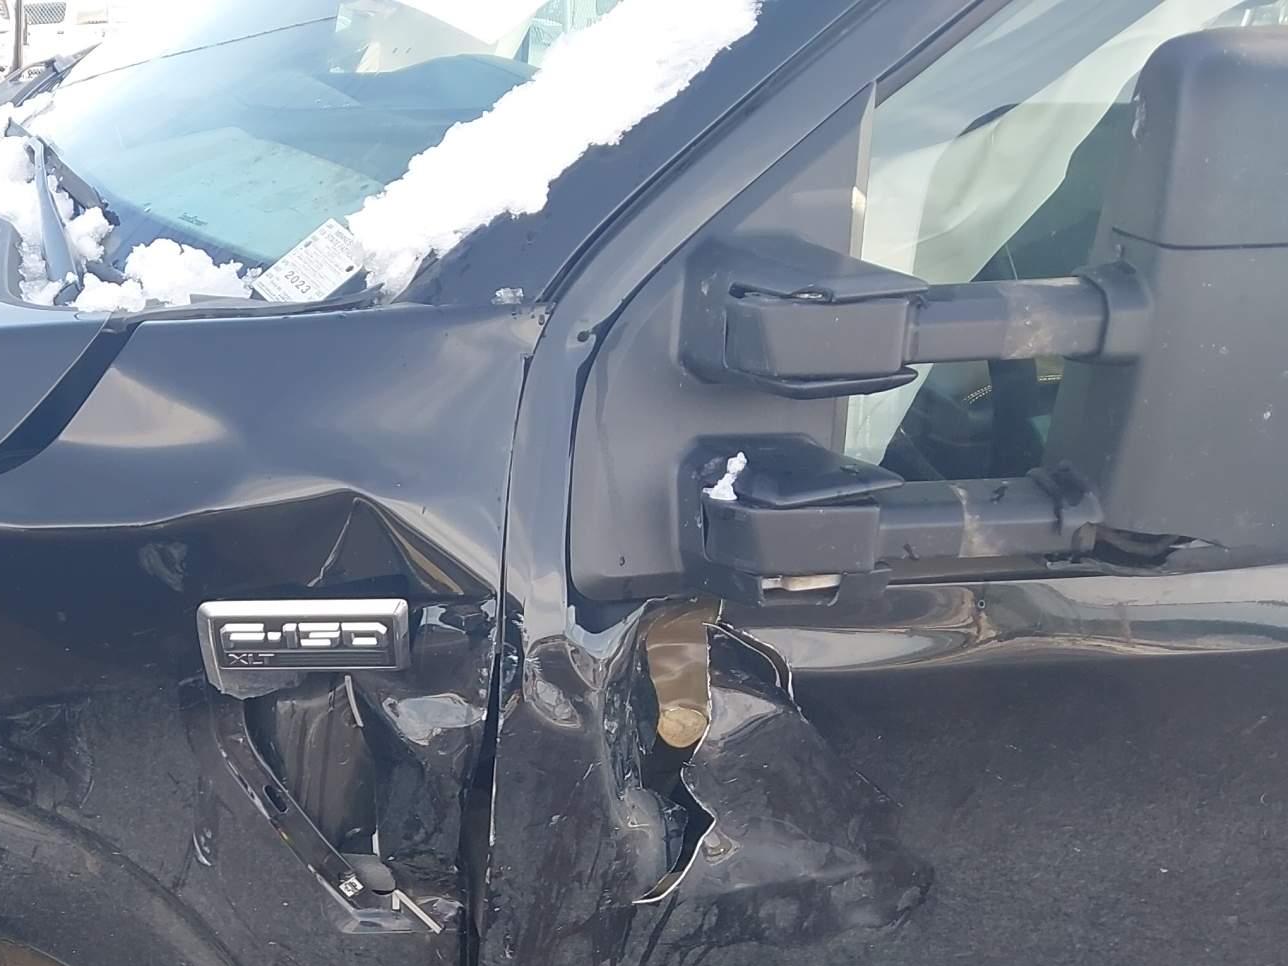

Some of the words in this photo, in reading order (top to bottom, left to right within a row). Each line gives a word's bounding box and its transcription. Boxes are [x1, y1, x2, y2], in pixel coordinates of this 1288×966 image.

[284, 271, 312, 294] 2023
[220, 622, 388, 648] F-150
[228, 653, 276, 665] XLT
